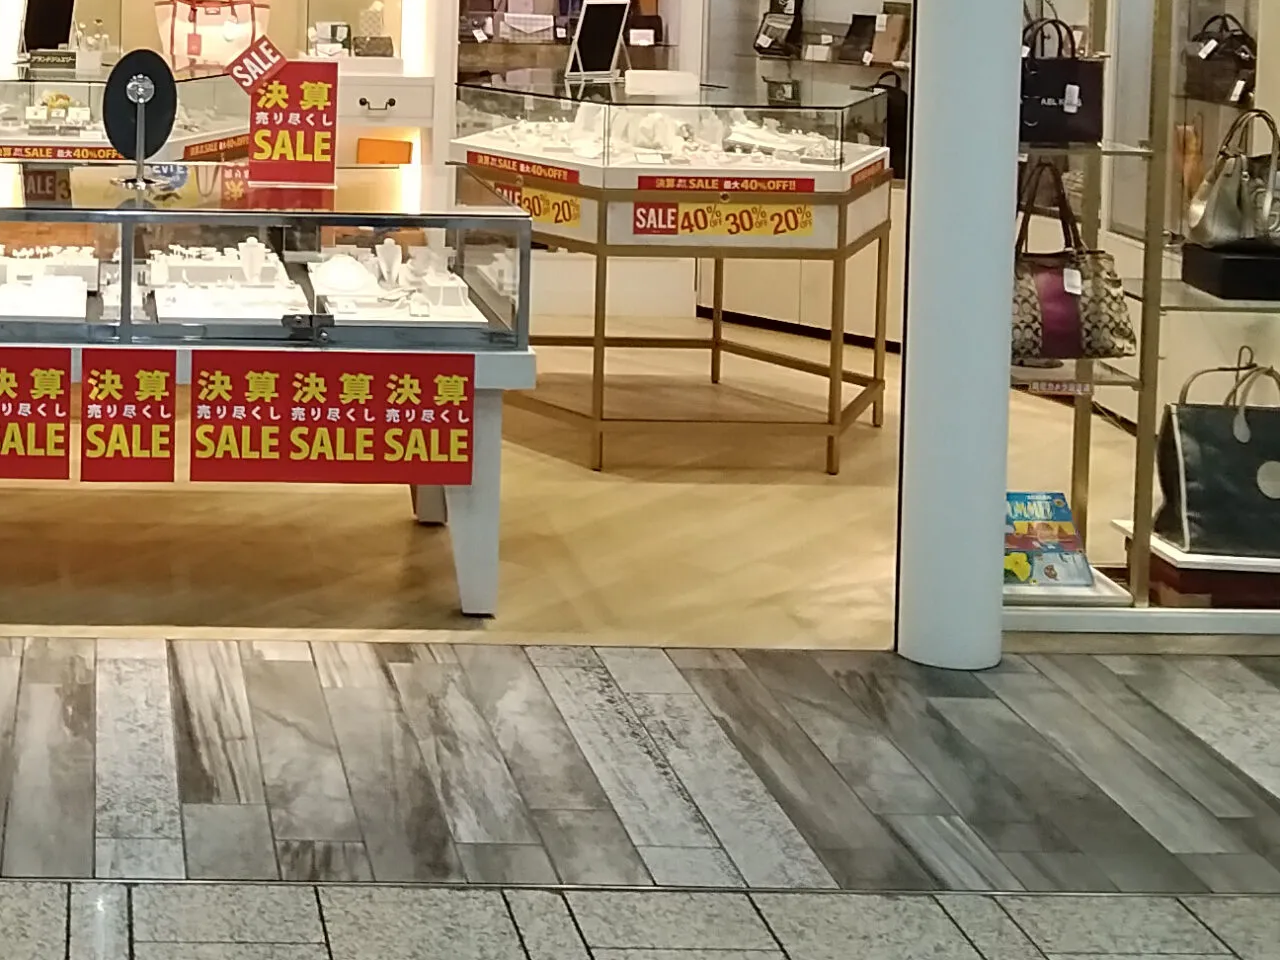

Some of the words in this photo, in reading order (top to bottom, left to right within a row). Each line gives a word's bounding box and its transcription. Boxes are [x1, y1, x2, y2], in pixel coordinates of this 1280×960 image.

[232, 40, 281, 87] SALE
[257, 80, 333, 110] 決算
[255, 111, 333, 126] 売り尽くし
[24, 147, 53, 158] SALE
[253, 129, 332, 162] SALE
[496, 158, 518, 172] SALE
[25, 175, 56, 196] ALE
[688, 178, 719, 189] SALE
[635, 207, 677, 229] SALE
[87, 369, 170, 402] 決算
[197, 370, 280, 403] 決算
[292, 372, 374, 405] 決算
[386, 374, 468, 407] 決算
[86, 403, 172, 420] 売り尽くし
[196, 405, 282, 421] 売り尽くし
[291, 406, 376, 423] 売り尽くし
[385, 408, 470, 425] 売り尽くし
[86, 423, 170, 458] SALE
[195, 424, 280, 460] SALE
[289, 426, 375, 461] SALE
[383, 428, 469, 463] SALE
